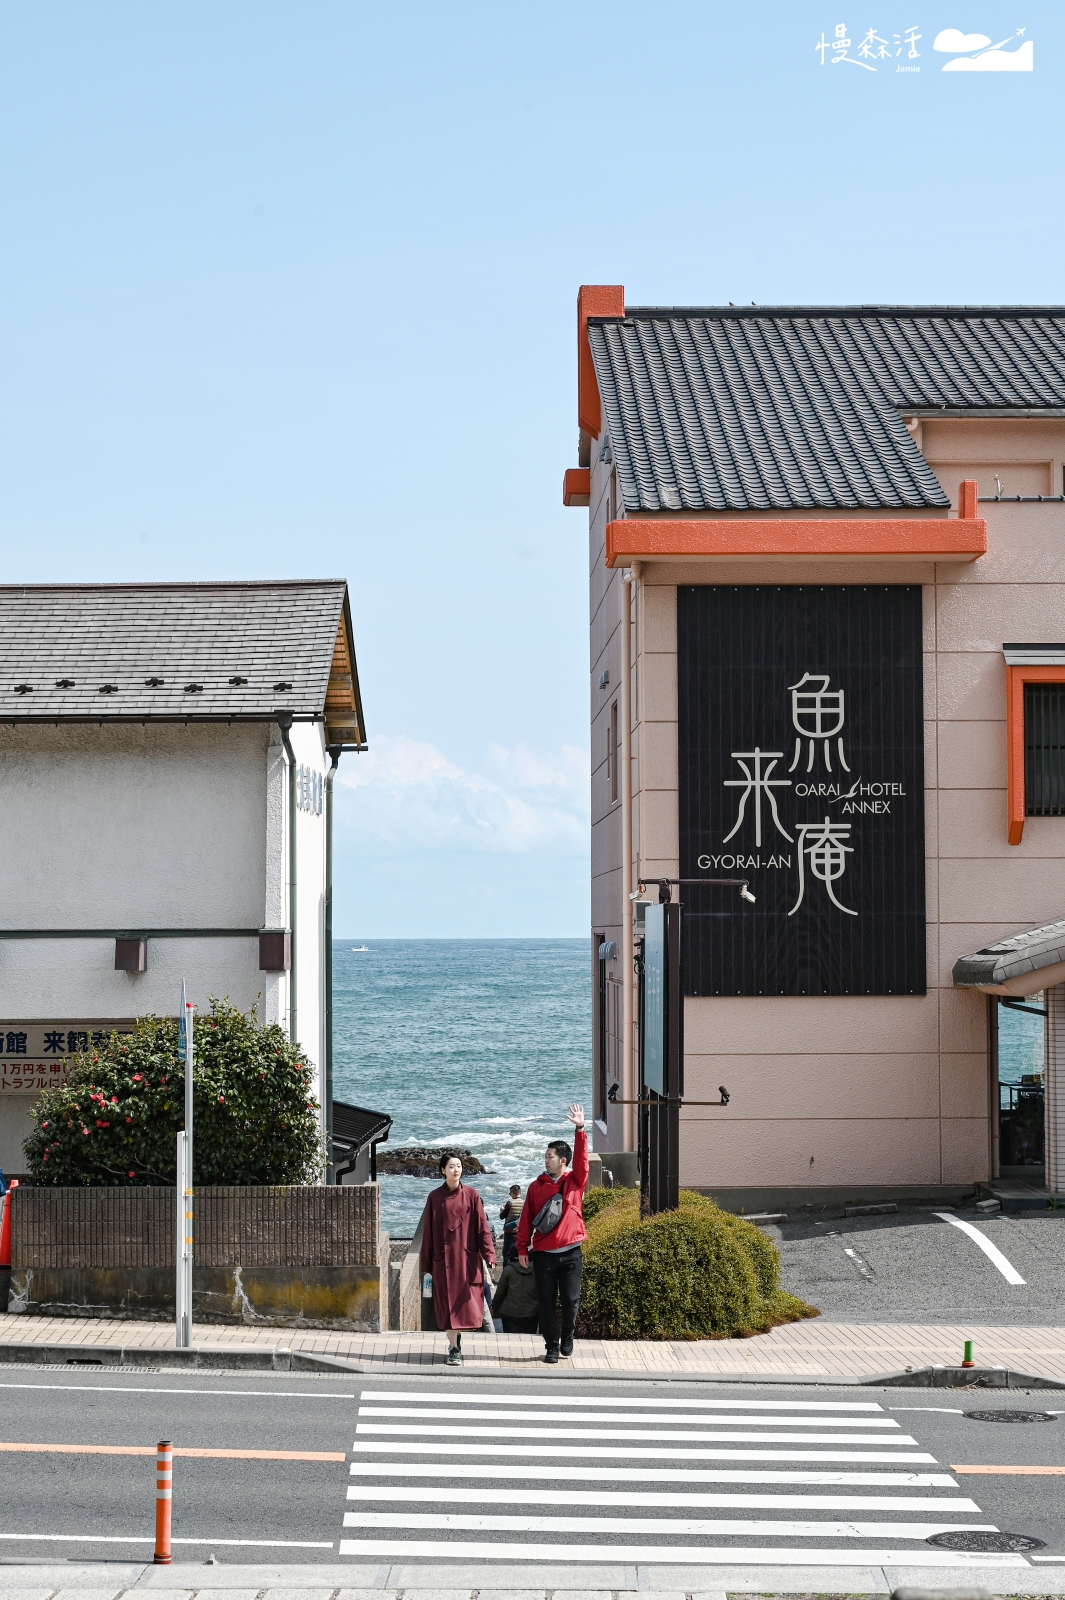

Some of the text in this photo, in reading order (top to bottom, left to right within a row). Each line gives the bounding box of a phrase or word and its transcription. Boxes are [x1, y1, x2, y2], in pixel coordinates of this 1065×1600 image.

[795, 782, 906, 796] OARAI HOTEL
[841, 800, 891, 814] ANNEX
[697, 854, 791, 869] GYORAI-AN
